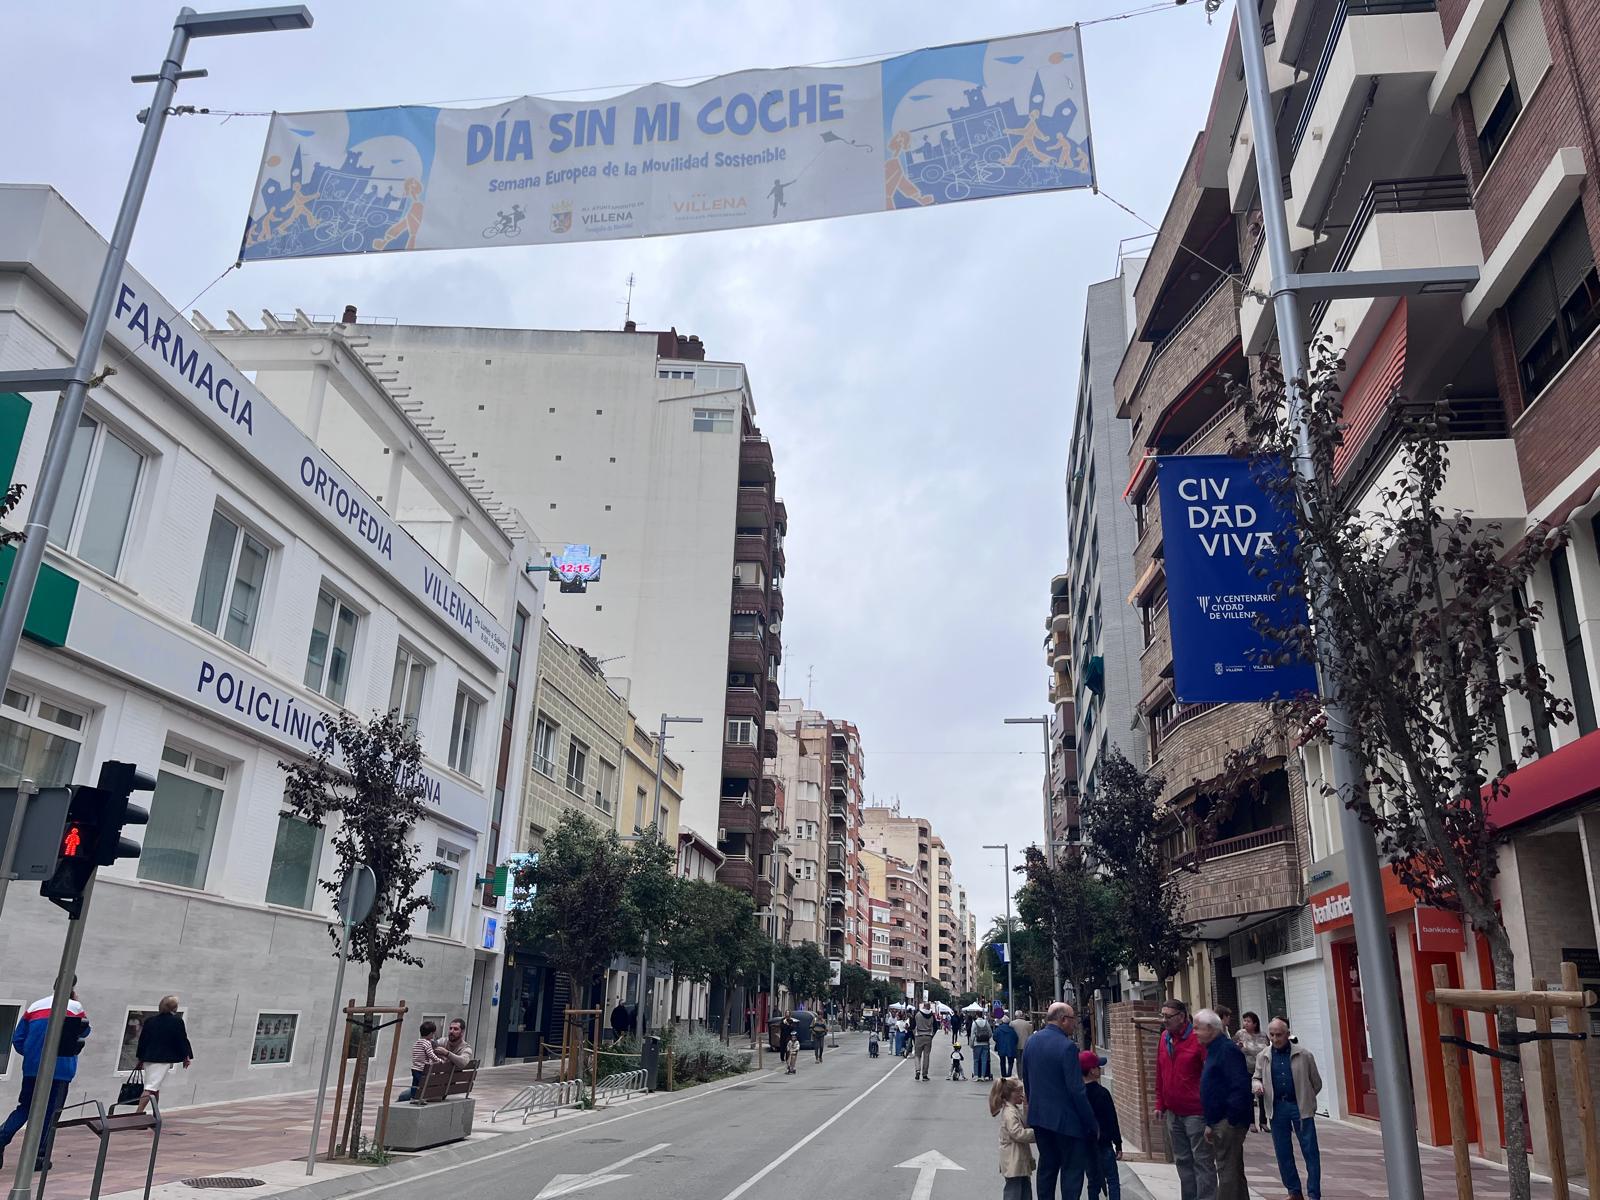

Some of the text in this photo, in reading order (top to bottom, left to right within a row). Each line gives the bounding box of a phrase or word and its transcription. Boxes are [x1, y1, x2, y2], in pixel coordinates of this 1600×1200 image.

[466, 83, 844, 166] DÍA SIN MI COCHE
[488, 147, 787, 192] Semana Europea de la Movilidad Sostenible
[672, 197, 747, 212] VILLENA
[582, 212, 633, 224] VILLENA
[114, 282, 473, 634] FARMACIA ORTOPEDIA VILLENA
[1178, 478, 1230, 501] CIV
[1187, 505, 1257, 529] DAD
[1198, 532, 1278, 557] VIVA
[560, 563, 591, 573] 12:15
[1211, 603, 1244, 612] CIVDAD
[1215, 595, 1221, 603] V
[1209, 611, 1257, 620] DE VILLENA
[197, 661, 335, 756] POLICLÍNICA
[1422, 925, 1460, 934] bankinter
